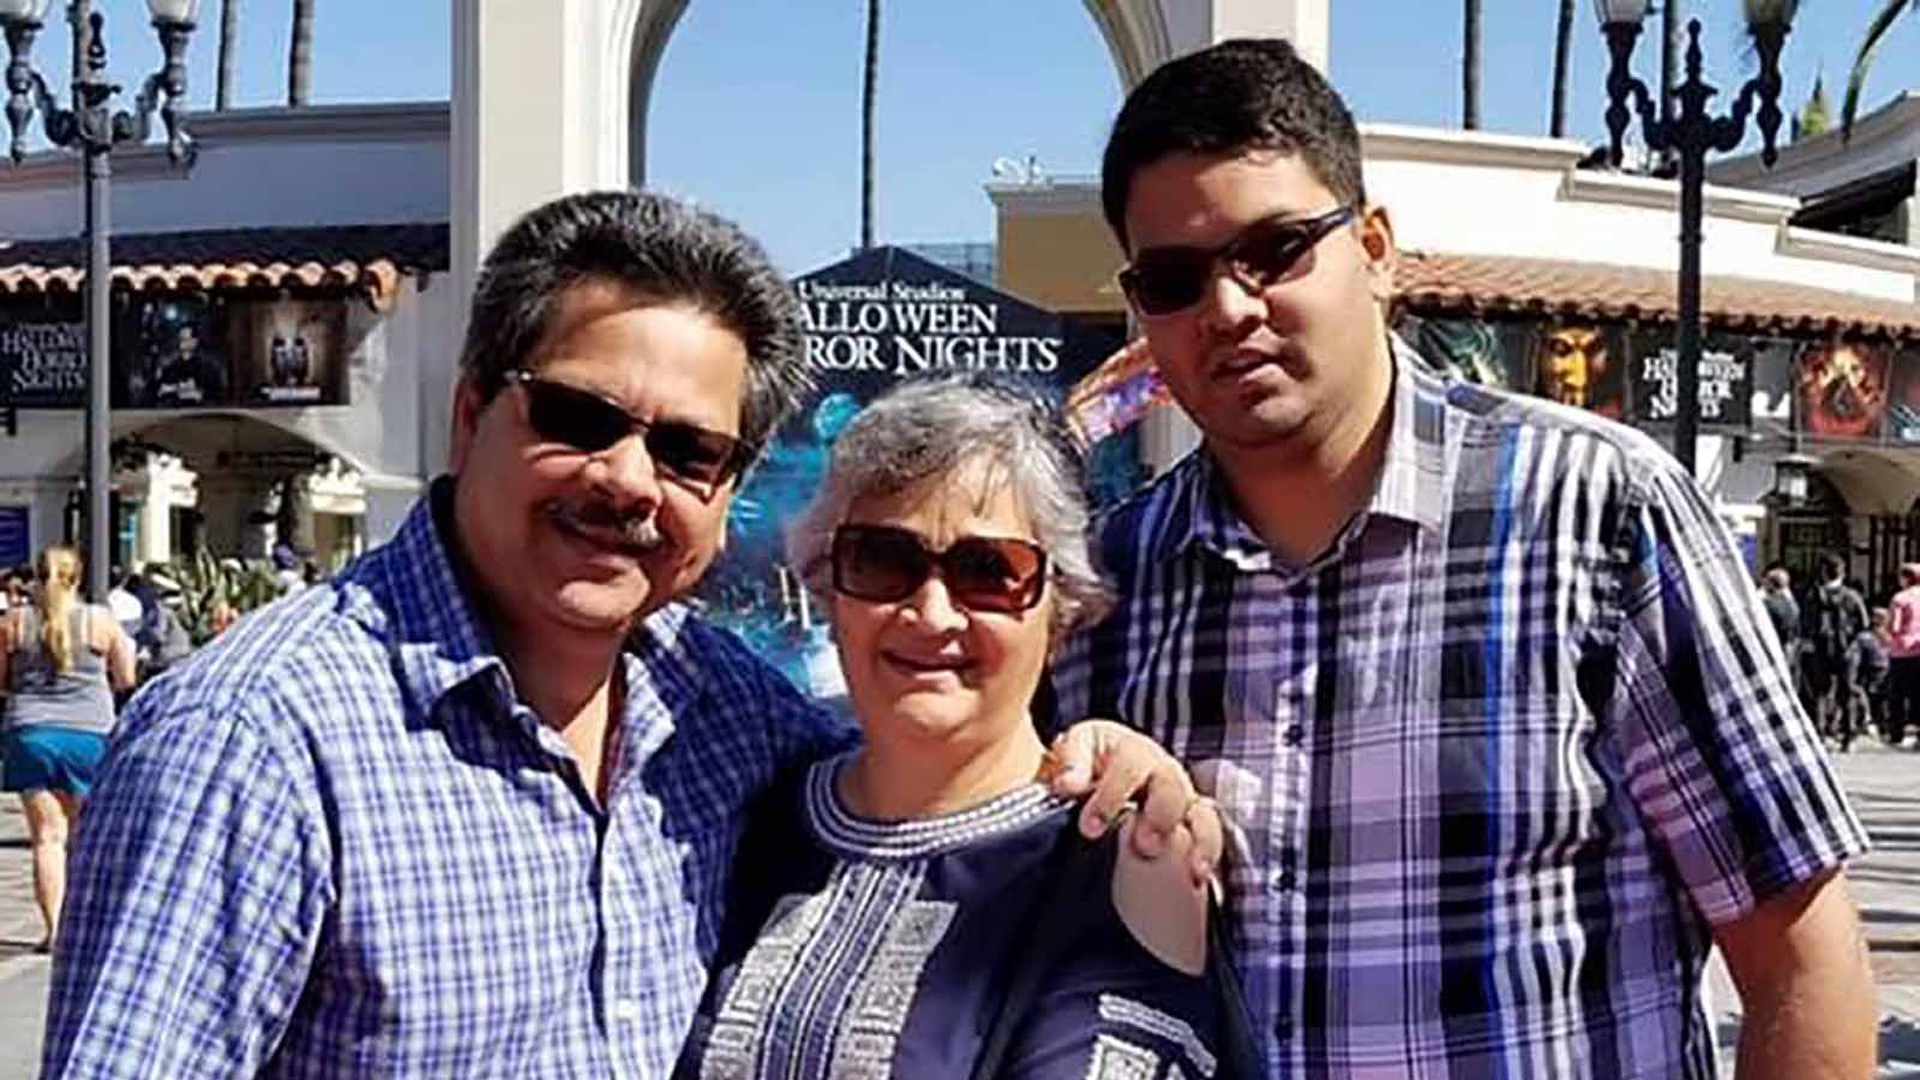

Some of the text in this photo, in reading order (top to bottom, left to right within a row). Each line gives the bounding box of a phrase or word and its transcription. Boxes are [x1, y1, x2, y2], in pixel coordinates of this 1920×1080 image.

[798, 280, 965, 300] Universal Studios
[799, 302, 998, 333] ALLOWEEN
[805, 335, 1063, 375] ROR NIGHTS
